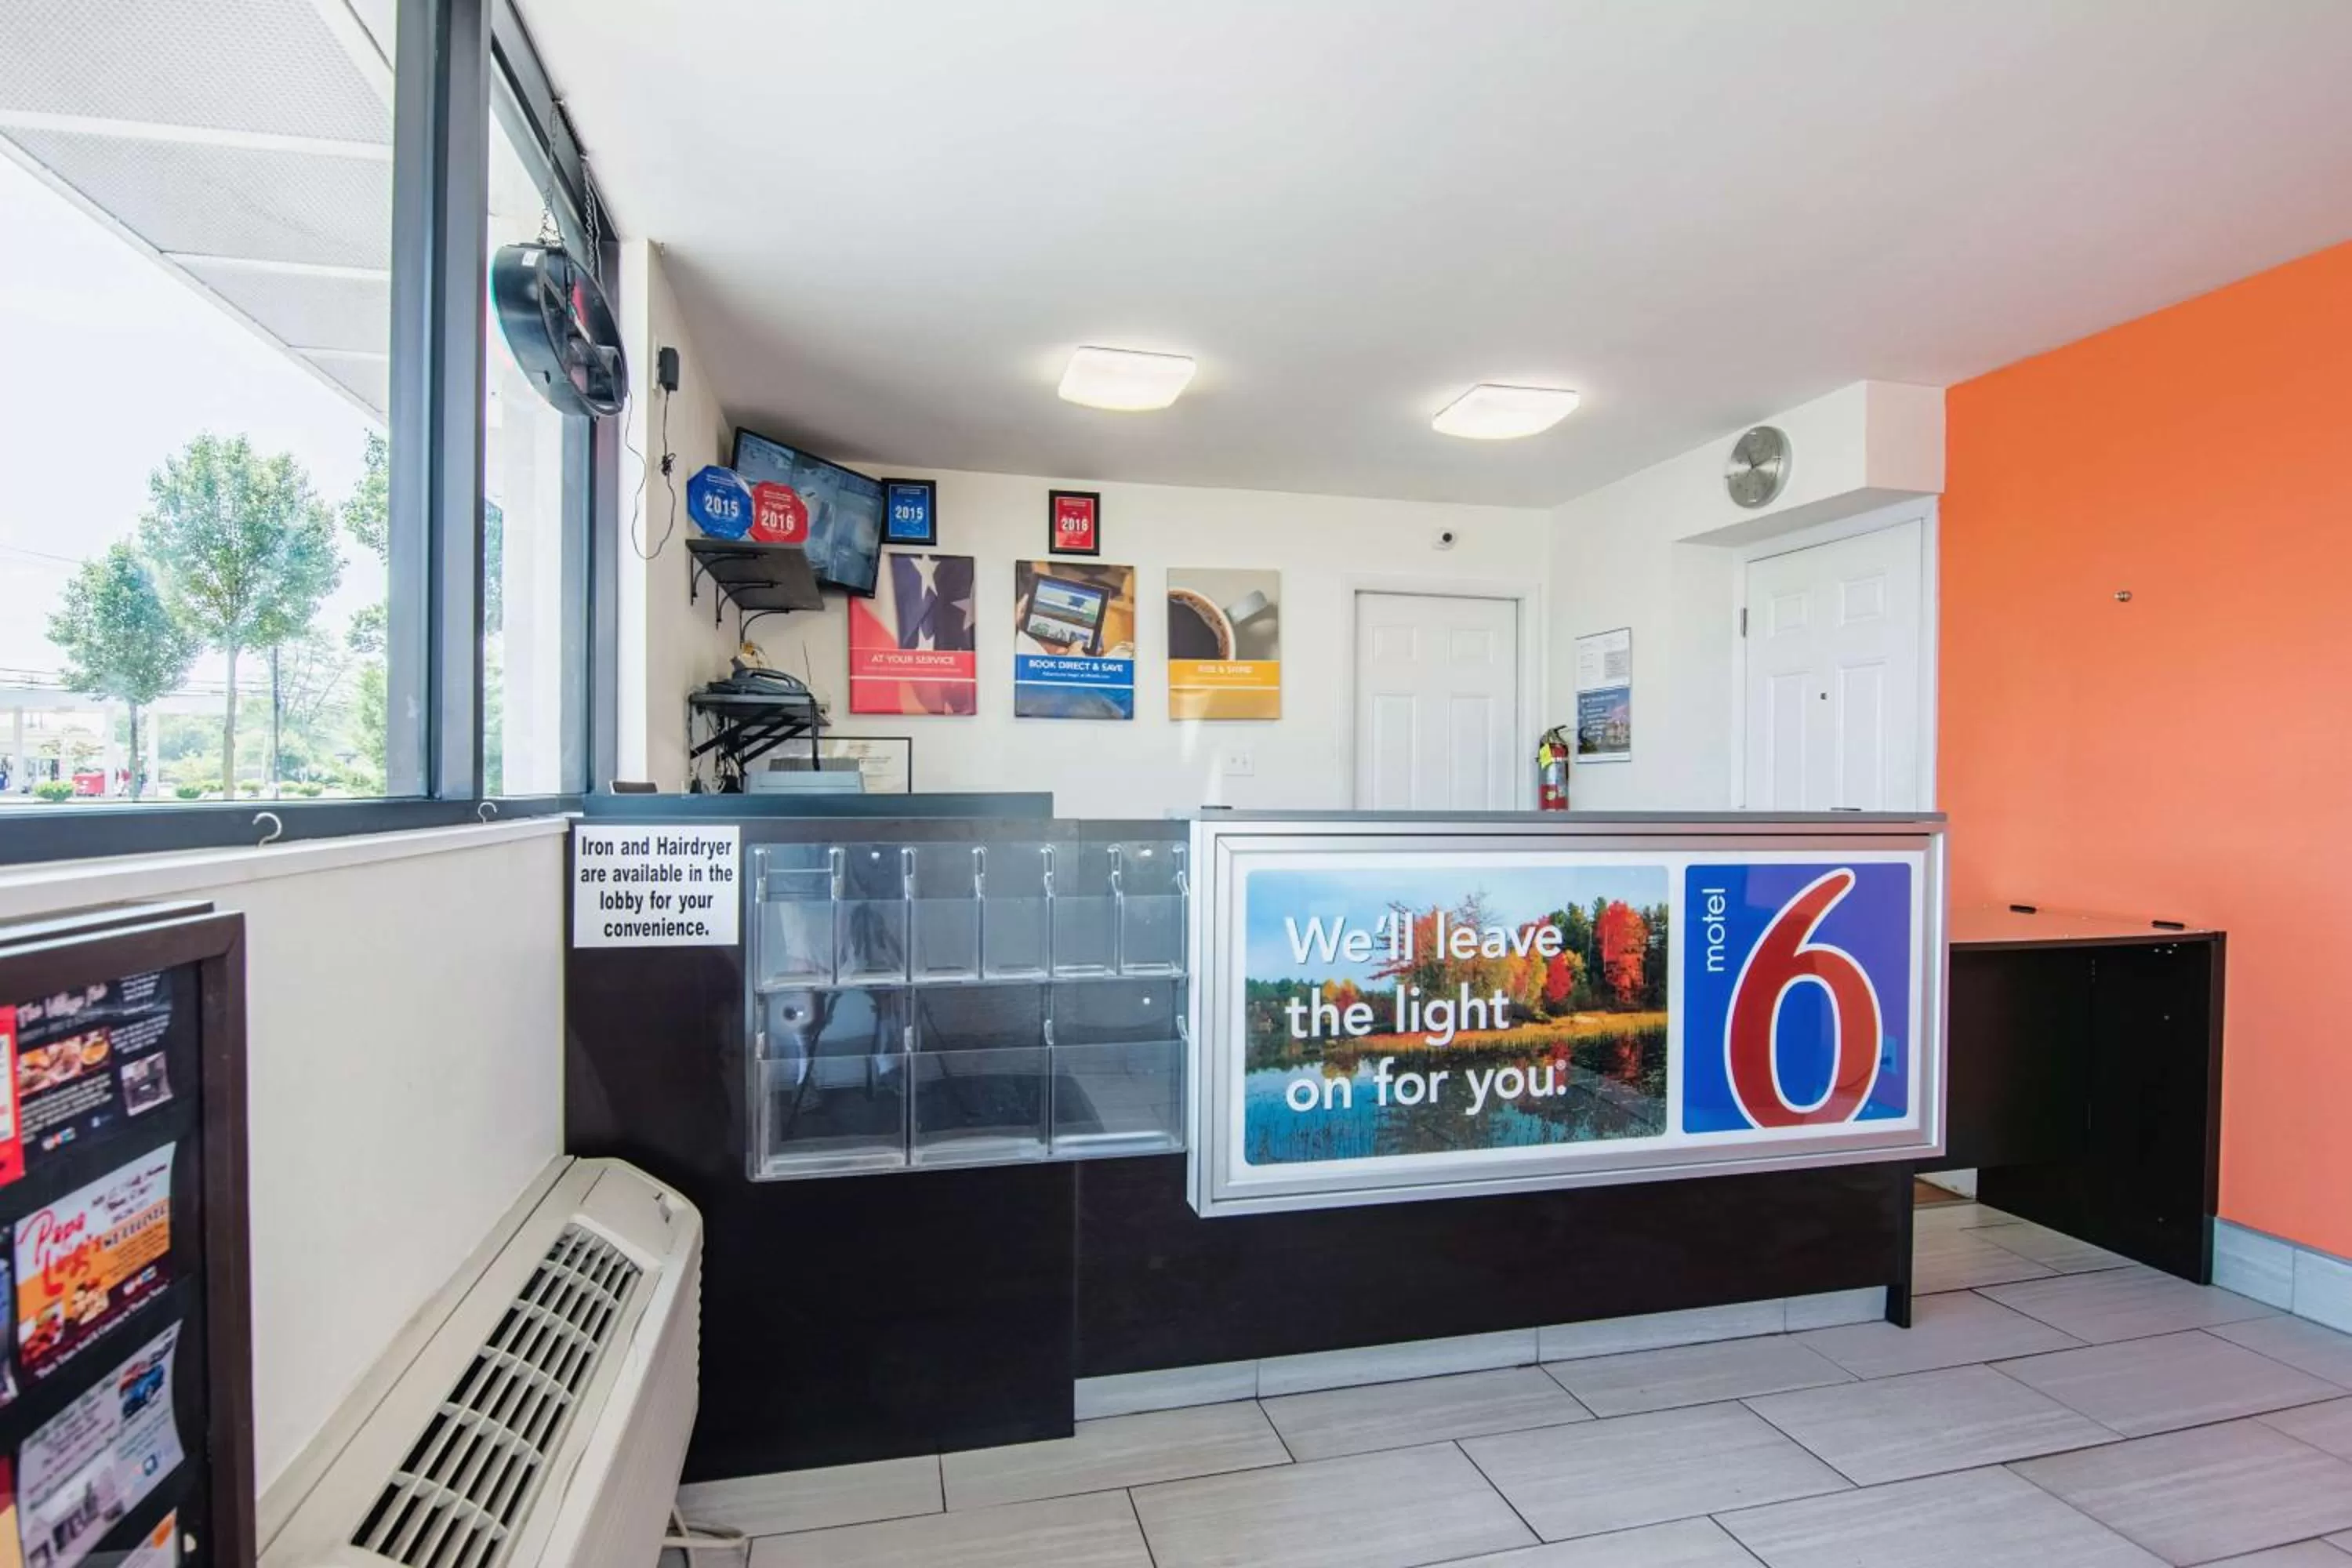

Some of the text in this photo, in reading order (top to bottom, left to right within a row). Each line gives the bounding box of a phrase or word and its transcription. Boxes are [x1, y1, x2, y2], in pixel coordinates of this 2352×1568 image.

[704, 494, 739, 517] 2015
[895, 505, 924, 521] 2015
[760, 510, 795, 532] 2016
[1060, 516, 1089, 532] 2016
[871, 654, 955, 665] AT YOUR SERVICE
[1028, 659, 1124, 673] BOOK DIRECT & SAVE
[582, 836, 732, 860] Iron and Hairdryer
[580, 863, 733, 882] are available in the
[600, 890, 713, 914] lobby for your
[604, 917, 710, 937] convenience.
[1284, 910, 1563, 965] We'll leave
[1701, 887, 1726, 972] motel
[1723, 867, 1883, 1129] 6
[1284, 982, 1511, 1047] the light
[1284, 1075, 1352, 1112] on
[1373, 1056, 1449, 1106] for
